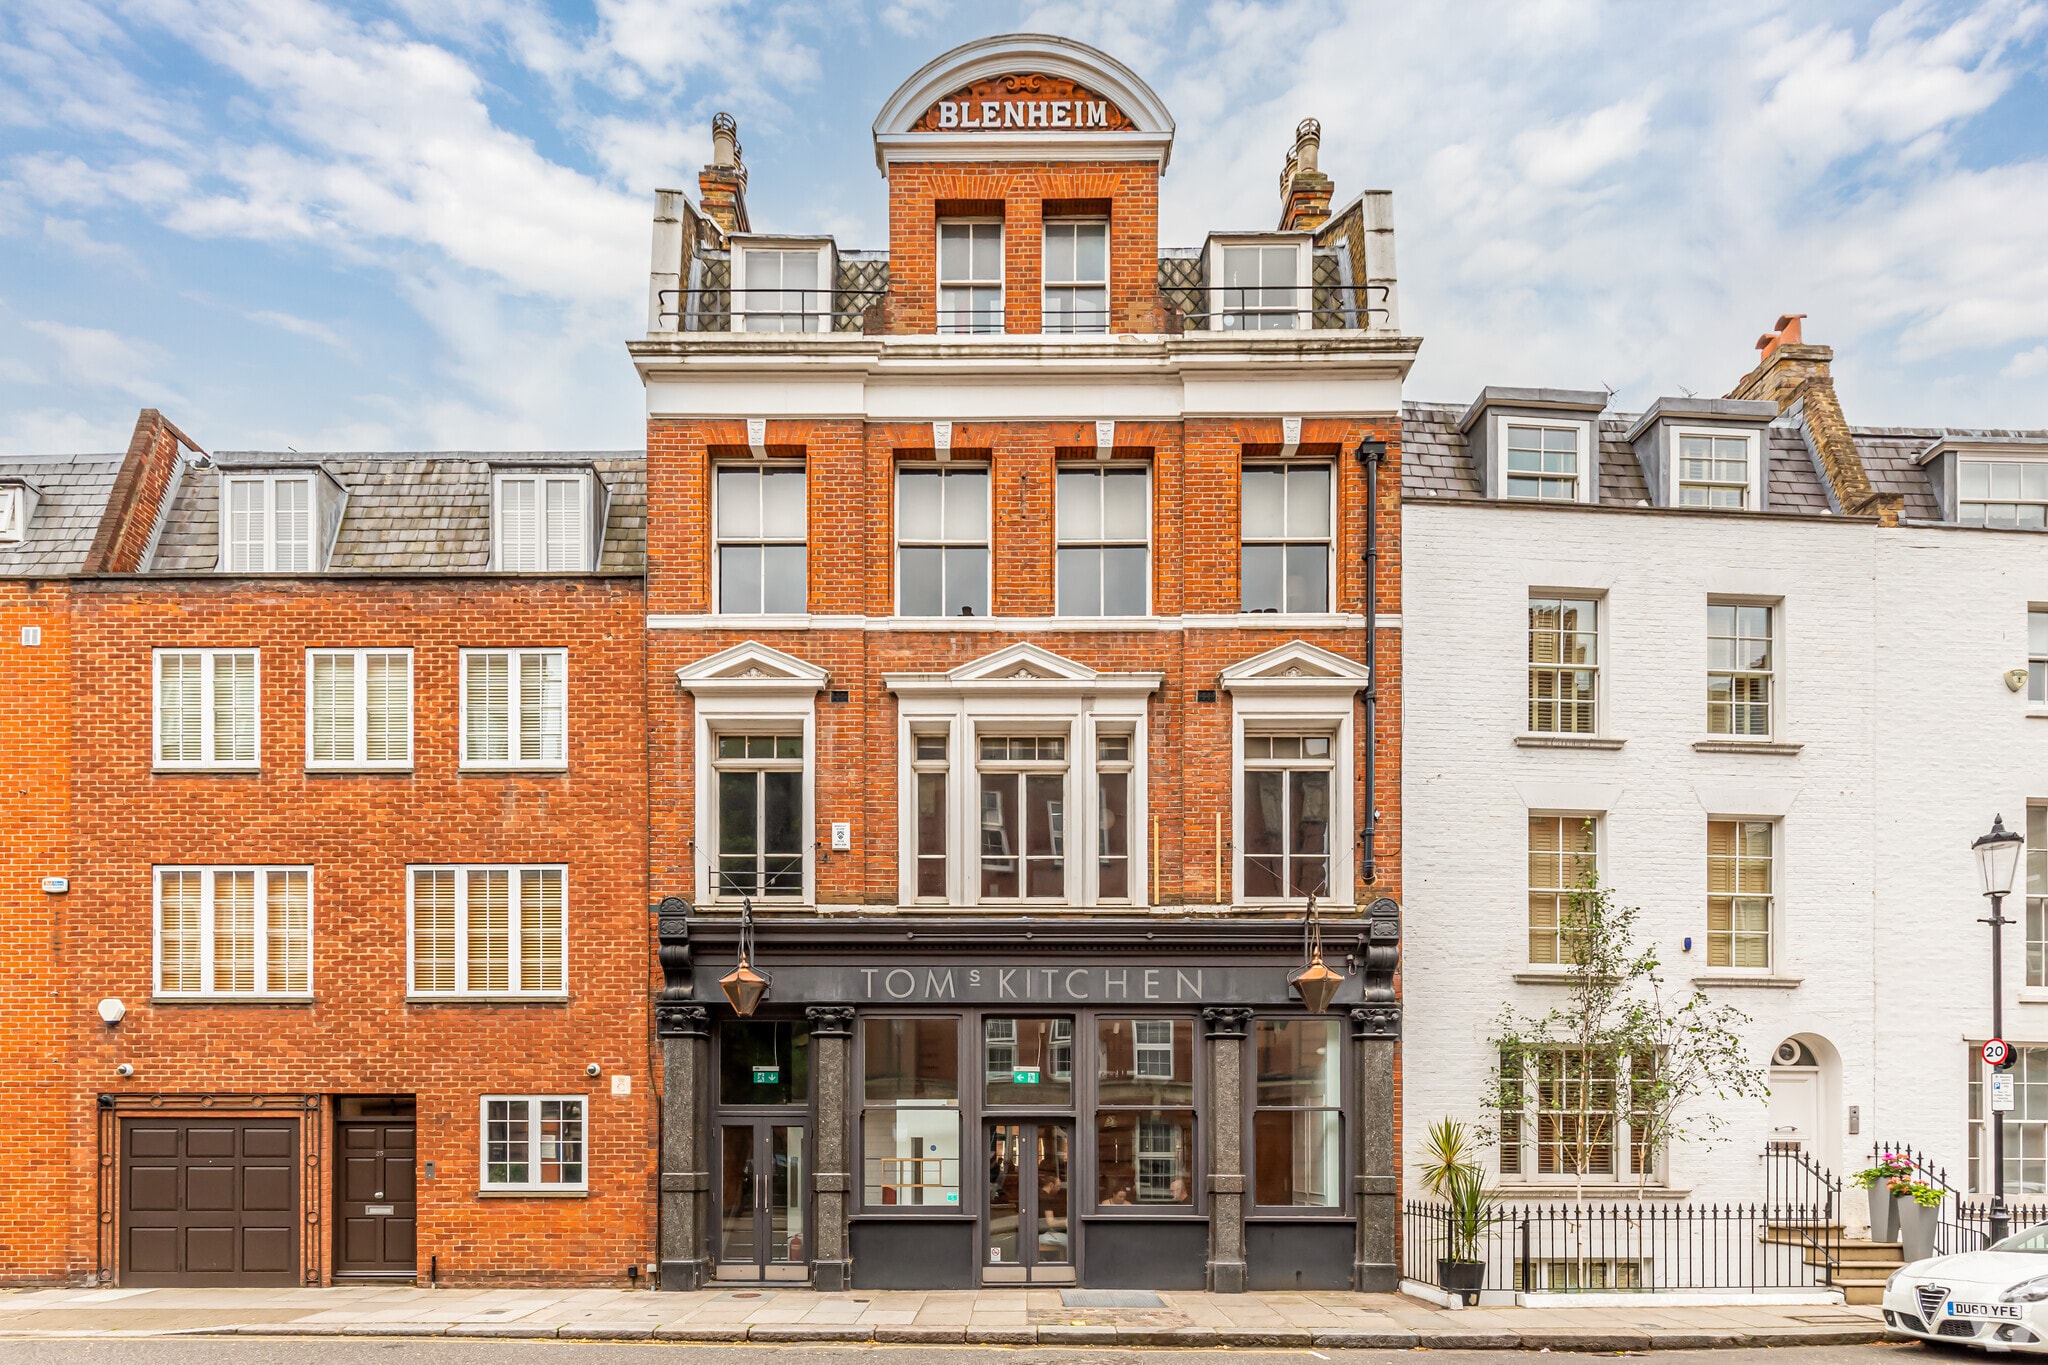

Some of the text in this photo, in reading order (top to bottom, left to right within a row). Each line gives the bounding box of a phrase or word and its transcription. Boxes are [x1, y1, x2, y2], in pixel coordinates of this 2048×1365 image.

[938, 101, 1108, 128] BLENHEIM
[999, 968, 1203, 999] KITCHEN
[1985, 1045, 2004, 1058] 20
[1955, 1303, 2019, 1317] DU60 YFE
